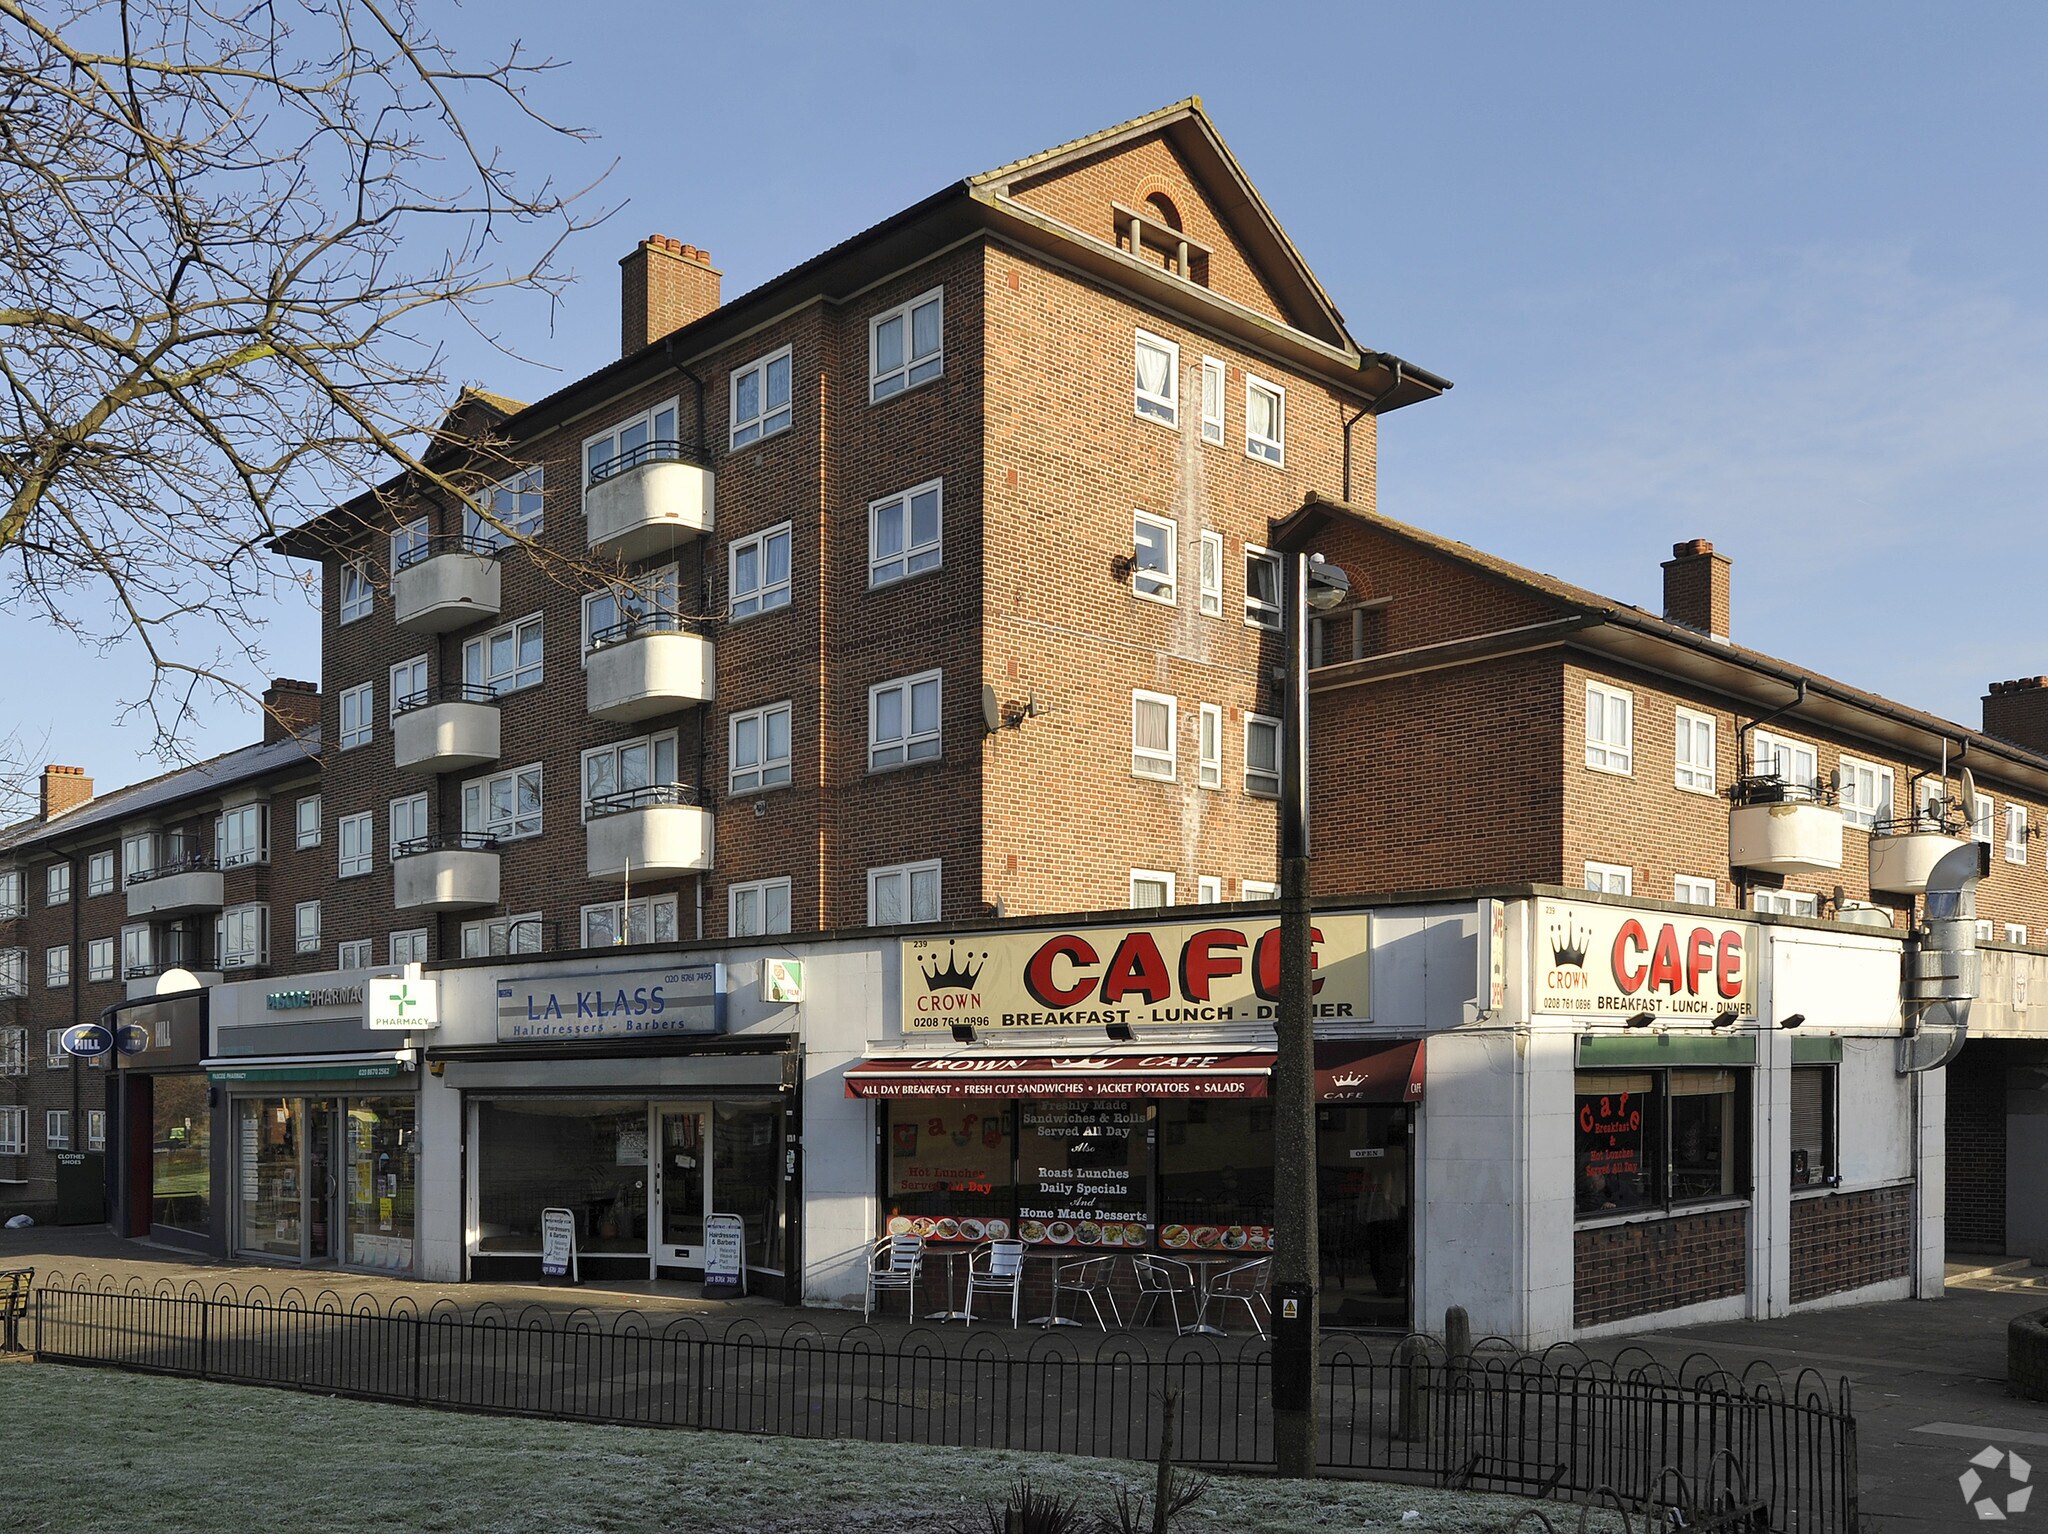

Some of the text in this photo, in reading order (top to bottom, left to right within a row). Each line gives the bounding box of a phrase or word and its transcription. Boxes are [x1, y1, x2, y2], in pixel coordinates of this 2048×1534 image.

[913, 940, 928, 948] 239
[1611, 918, 1743, 999] CAFE
[1024, 926, 1325, 1010] CAFE
[665, 972, 712, 984] 020 8761 7495
[1547, 970, 1588, 989] CROWN
[310, 986, 363, 1006] PHARMAC
[528, 987, 665, 1021] LA KLASS
[917, 993, 981, 1012] CROWN
[1544, 997, 1591, 1010] 0208 761 0896
[1598, 996, 1662, 1012] BREAKFAST
[1673, 1000, 1708, 1013] LUNCH
[1717, 1001, 1752, 1015] DINNER
[1002, 1010, 1130, 1026] BREAKFAST
[1152, 1006, 1233, 1021] LUNCH
[1257, 1003, 1353, 1019] DIER
[514, 1023, 604, 1036] Hairdressers
[626, 1019, 685, 1031] Barbers
[914, 1017, 939, 1027] 0208
[942, 1017, 960, 1026] 761
[155, 1021, 171, 1047] HILL
[75, 1039, 100, 1050] HILL
[911, 1056, 1218, 1070] CROWN CAFE
[863, 1082, 1245, 1094] ALL DAY BREAKFAST FRESH CUT SANDWICHES JACKET POTATOES SALADS
[1410, 1083, 1422, 1093] CAFE
[1041, 1101, 1127, 1112] Freshly Made
[1023, 1113, 1146, 1124] Sandwiches & Rolls
[1037, 1126, 1131, 1138] Served All Day
[1595, 1122, 1630, 1134] Breakfast
[1609, 1136, 1616, 1146] &
[1071, 1142, 1095, 1153] Also
[909, 1167, 986, 1179] Hot Lunches
[1038, 1167, 1129, 1179] Roast Lunches
[967, 1182, 992, 1194] Day
[1040, 1182, 1128, 1195] Daily Specials
[1069, 1197, 1096, 1206] And
[1019, 1207, 1147, 1221] Home Made Desserts
[708, 1231, 739, 1239] Hairdressers
